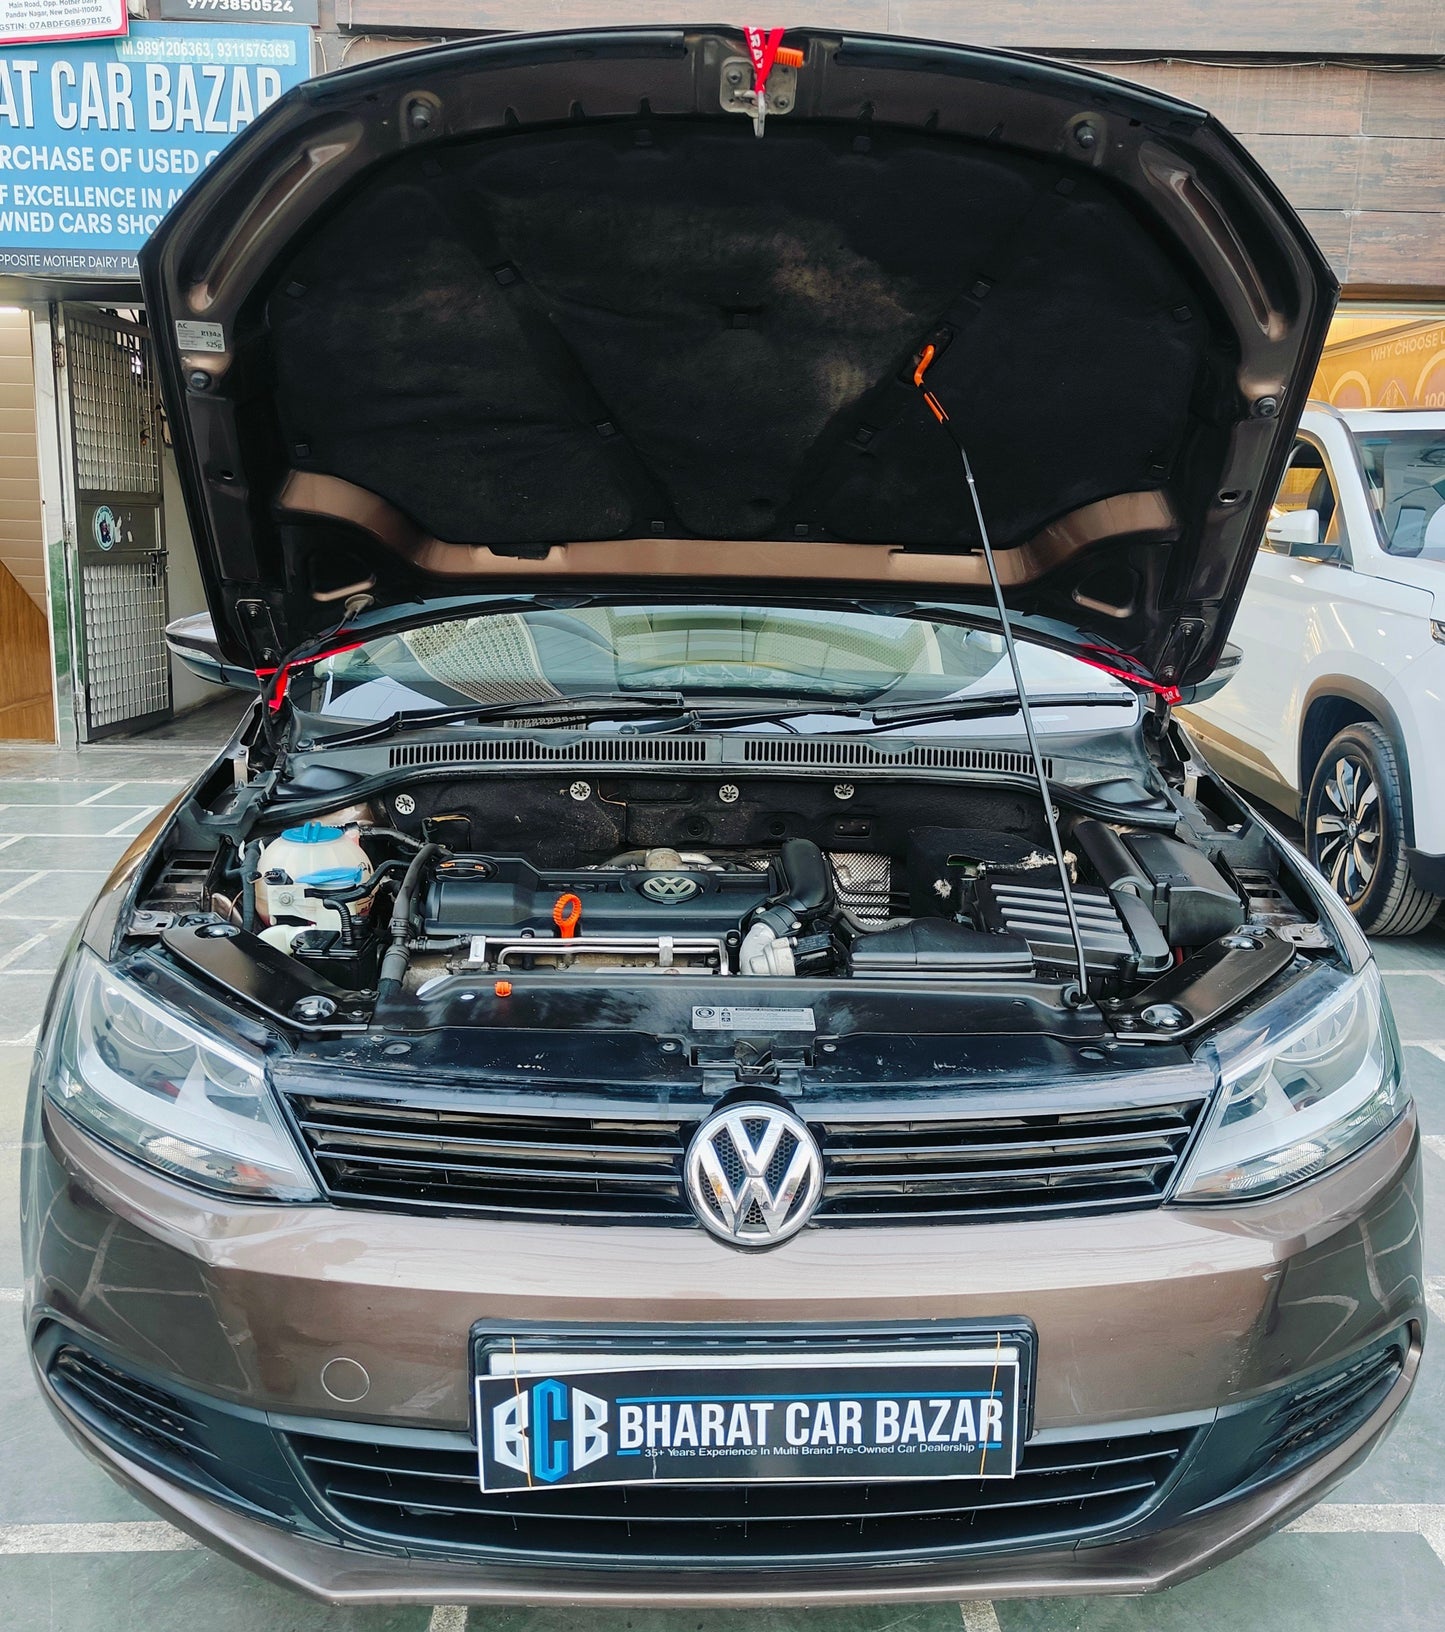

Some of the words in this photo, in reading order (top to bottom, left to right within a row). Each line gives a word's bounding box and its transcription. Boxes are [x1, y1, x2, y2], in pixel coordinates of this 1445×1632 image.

[217, 43, 290, 58] 9311576363
[0, 60, 38, 129] AT
[51, 60, 136, 131] CAR
[0, 145, 95, 172] RCHASE
[100, 147, 132, 173] OF
[138, 148, 199, 174] USED
[14, 185, 136, 209] EXCELLENCE
[141, 187, 162, 208] IN
[59, 212, 113, 234] CARS
[117, 213, 164, 235] SHO
[43, 255, 86, 267] MOTHER
[88, 255, 118, 268] DAIRY
[1371, 343, 1394, 361] WHY
[1395, 333, 1439, 356] CHOOSE
[619, 1403, 775, 1449] BHARAT
[785, 1401, 863, 1446] CAR
[875, 1399, 1004, 1444] BAZAR
[644, 1447, 665, 1458] 35+
[667, 1447, 697, 1458] Years
[698, 1446, 758, 1459] Experience
[760, 1445, 771, 1456] In
[773, 1445, 799, 1456] Multi
[801, 1446, 833, 1456] Brand
[835, 1444, 895, 1455] Pre-Owned
[897, 1443, 916, 1454] Car
[919, 1442, 975, 1454] Dealership
